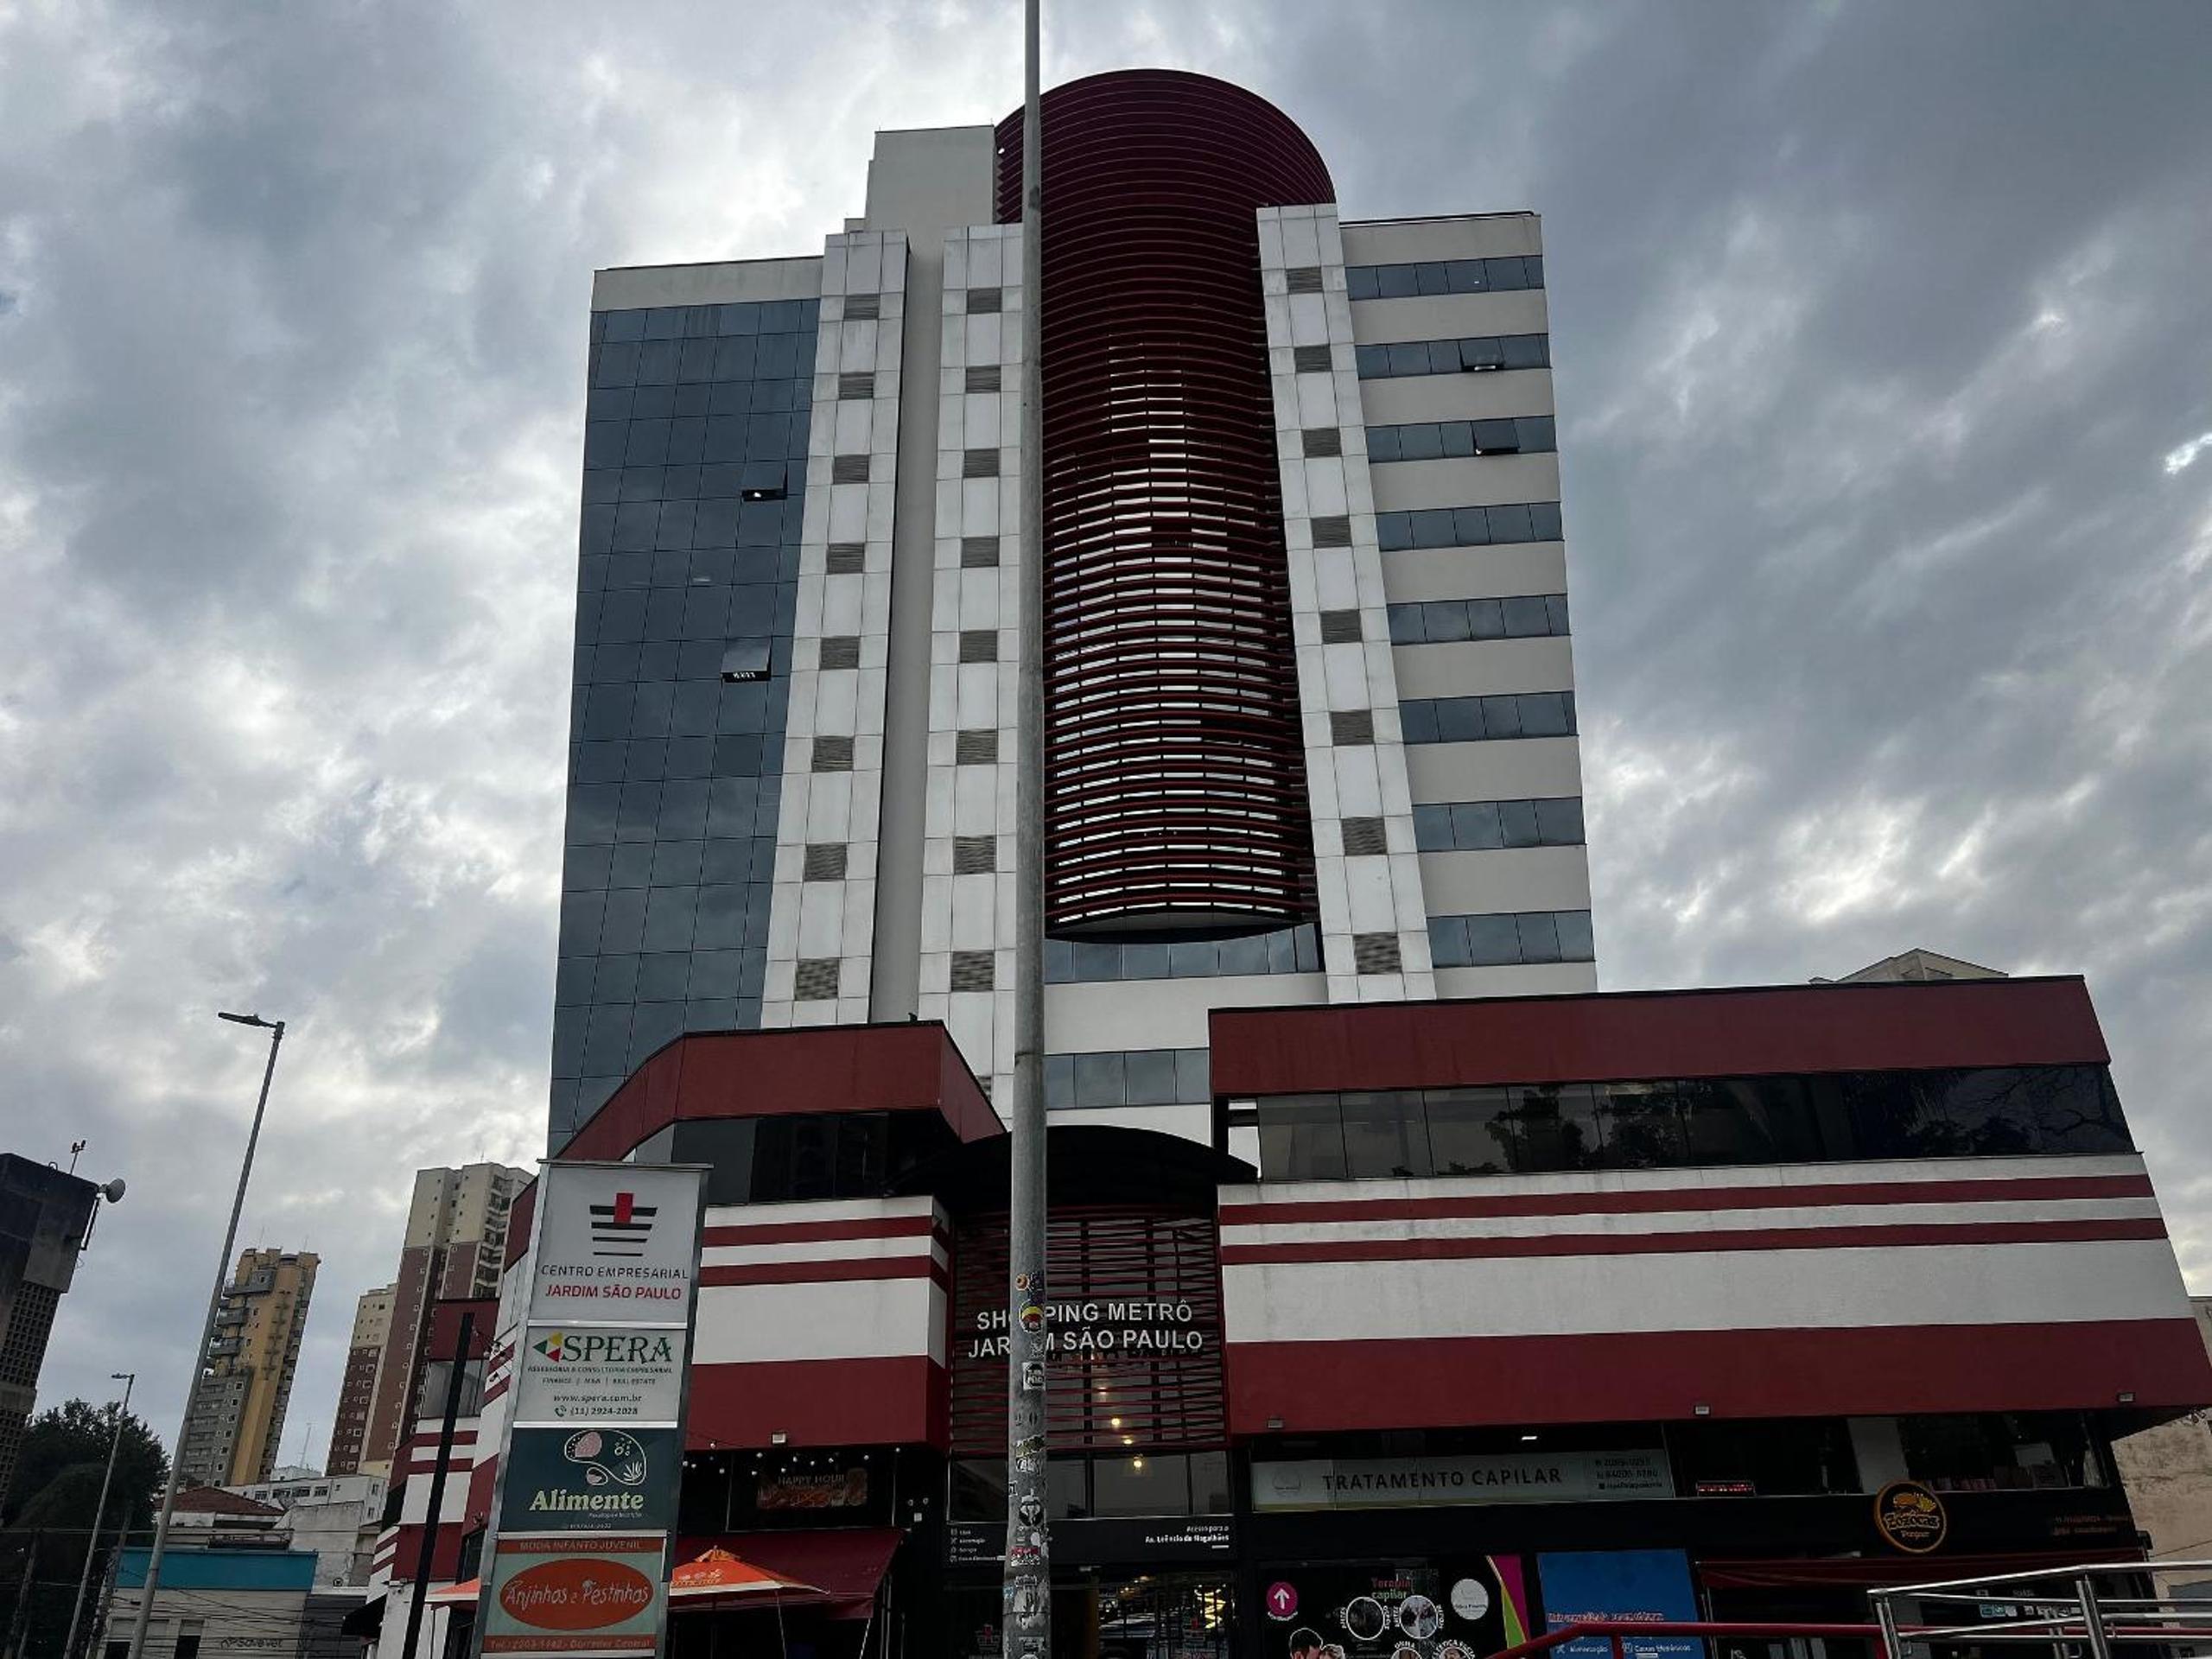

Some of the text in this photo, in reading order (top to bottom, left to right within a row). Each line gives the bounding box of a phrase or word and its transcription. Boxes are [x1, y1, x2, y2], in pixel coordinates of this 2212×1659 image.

[542, 1264, 689, 1280] CENTRO EMPRESARIAL
[545, 1284, 682, 1300] JARDIM SÃO PAULO
[976, 1299, 1192, 1332] SHPING METRÔ
[1063, 1326, 1115, 1351] SÃO
[1122, 1329, 1204, 1351] PAULO
[561, 1335, 672, 1364] SPERA
[553, 1394, 642, 1403] www.spera.com.br
[1322, 1468, 1562, 1491] TRATAMENTO CAPILAR
[529, 1488, 645, 1511] Alimente
[520, 1540, 642, 1550] MODA INFANTO JUVENIL
[1370, 1587, 1408, 1602] capilar
